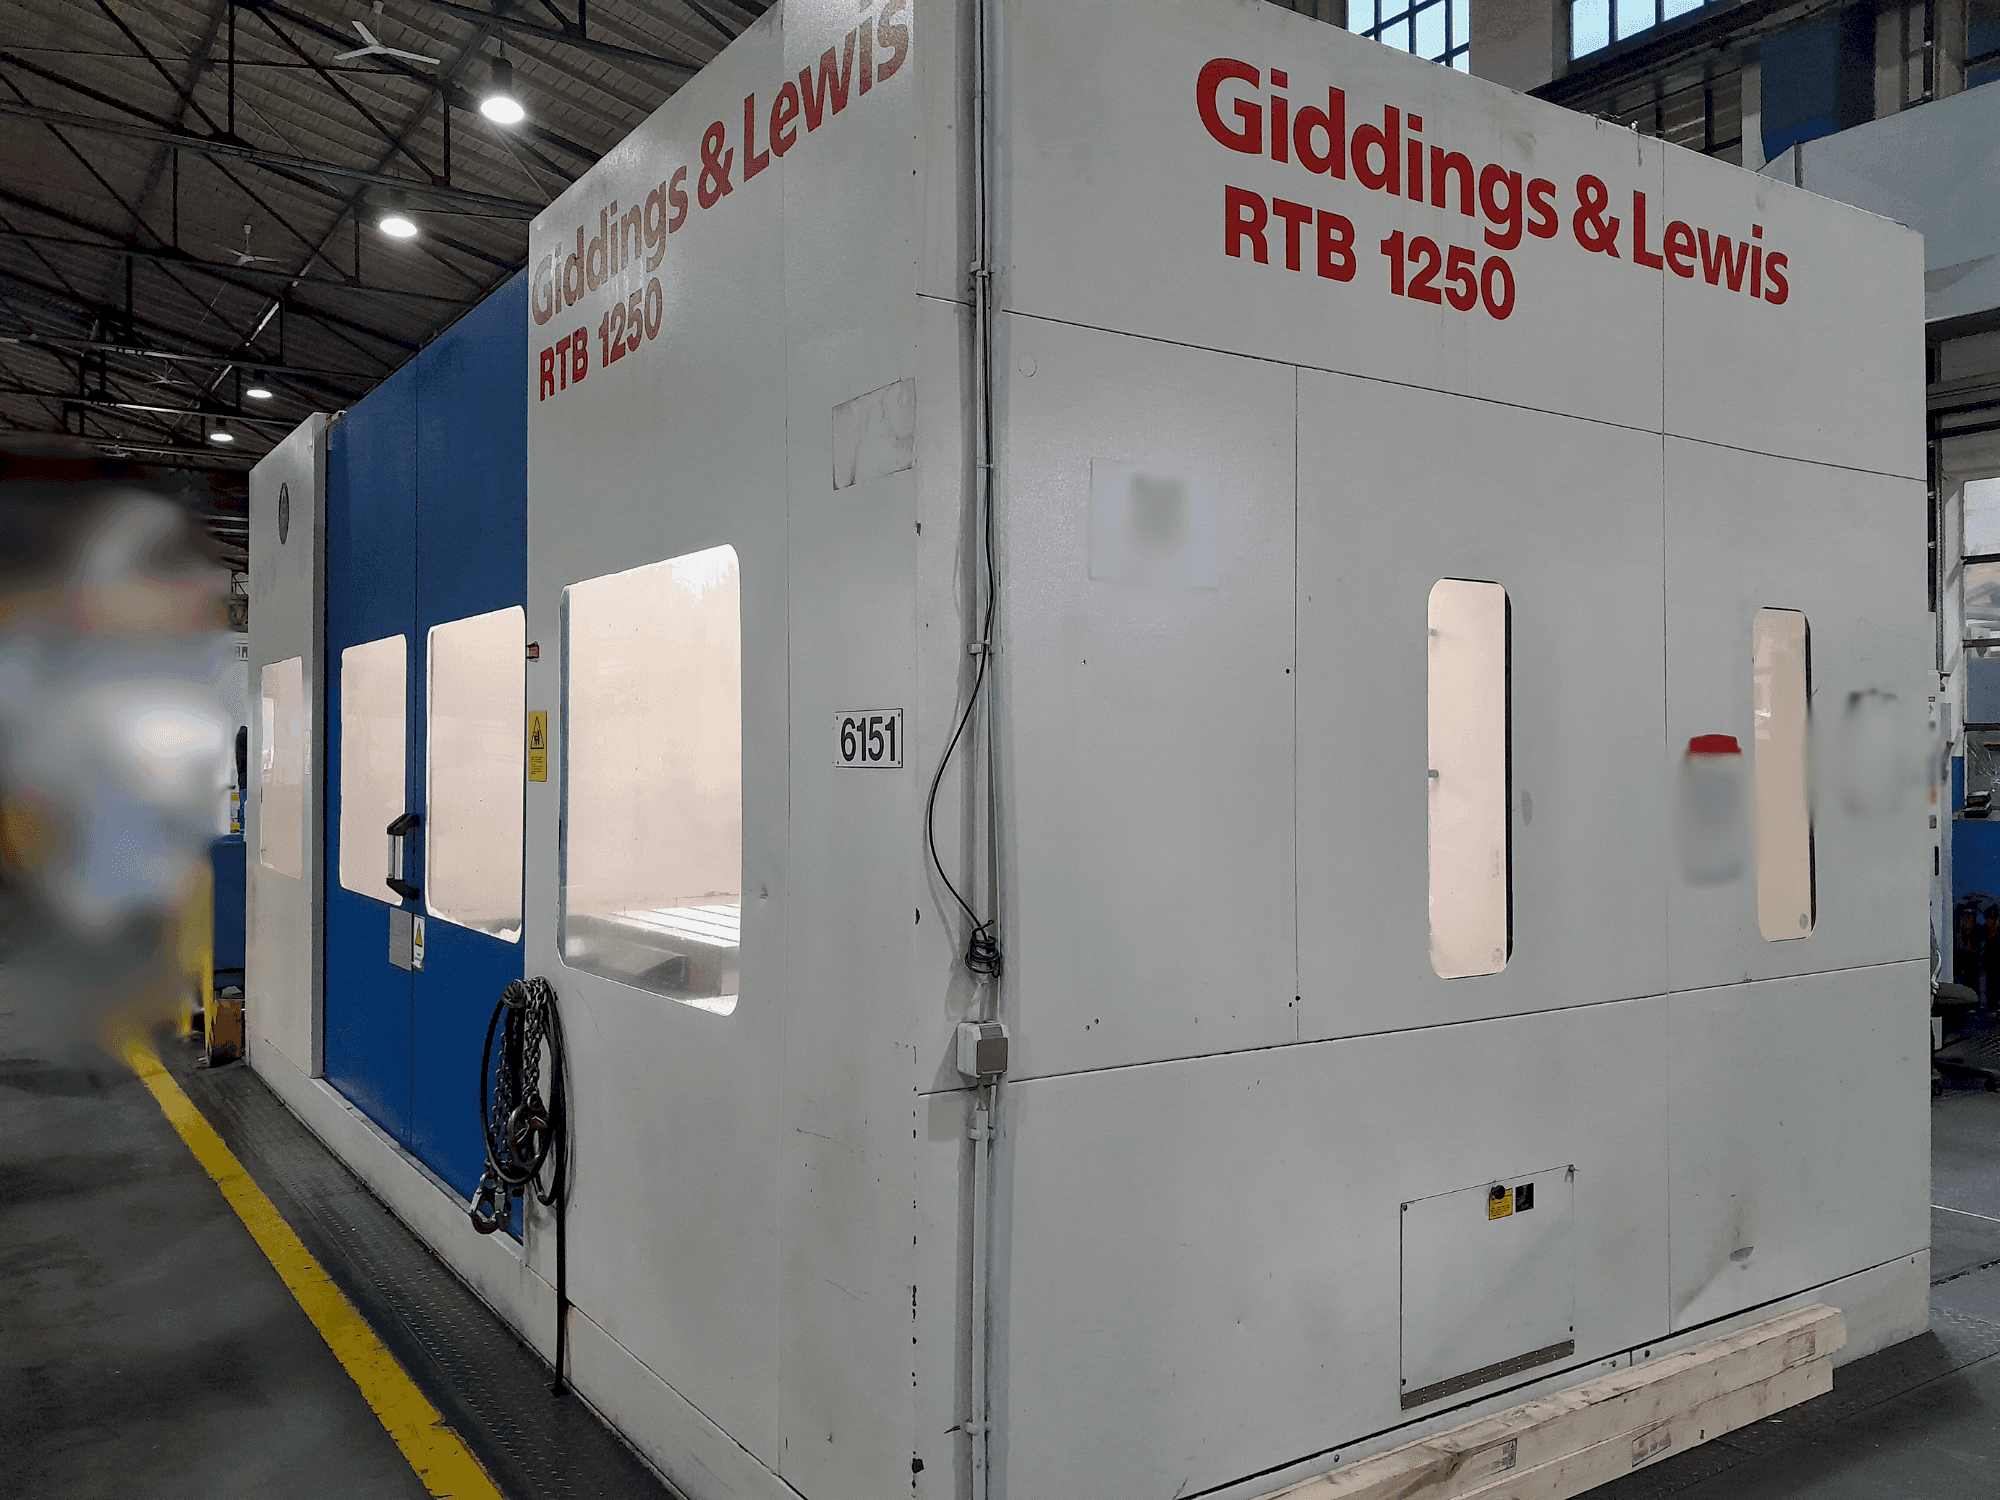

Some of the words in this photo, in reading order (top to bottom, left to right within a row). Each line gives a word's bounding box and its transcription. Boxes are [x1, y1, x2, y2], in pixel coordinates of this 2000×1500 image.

[531, 165, 688, 326] Giddings
[697, 120, 734, 210] &
[743, 0, 910, 183] Lewis
[1196, 57, 1559, 251] Giddings
[1572, 173, 1621, 259] &
[1633, 189, 1790, 305] Lewis
[1224, 184, 1357, 283] RTB
[1380, 229, 1516, 320] 1250
[540, 326, 588, 402] RTB
[598, 277, 663, 368] 1250
[840, 715, 896, 762] 6151
